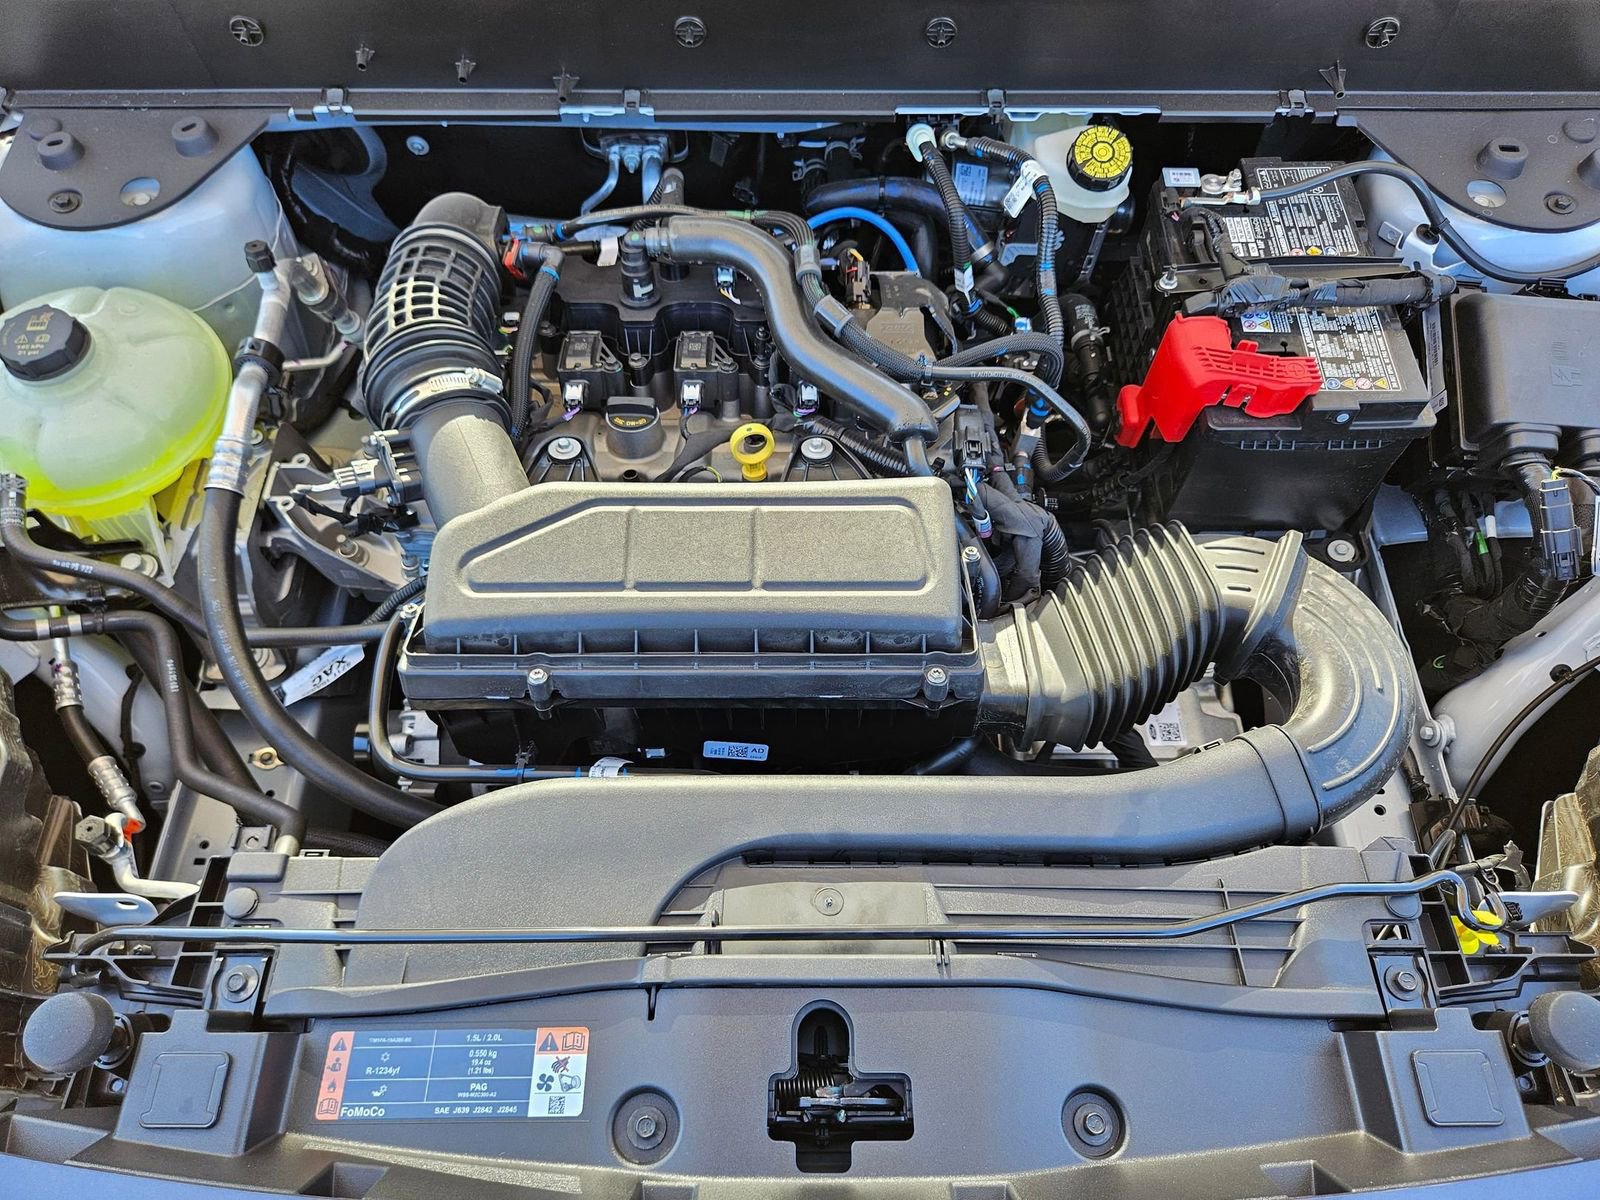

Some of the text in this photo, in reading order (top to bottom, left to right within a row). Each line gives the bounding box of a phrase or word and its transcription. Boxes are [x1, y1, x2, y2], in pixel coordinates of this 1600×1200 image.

[311, 655, 347, 687] XAC
[466, 1034, 481, 1042] 1.5L
[488, 1033, 503, 1041] 2.0L
[468, 1049, 498, 1059] 0.550 kg
[471, 1058, 483, 1066] 19.4
[365, 1066, 401, 1076] R-1234yf
[470, 1082, 488, 1091] PAG
[340, 1106, 386, 1117] FoMoCo
[434, 1105, 518, 1114] SAE J639 J2842 J2845
